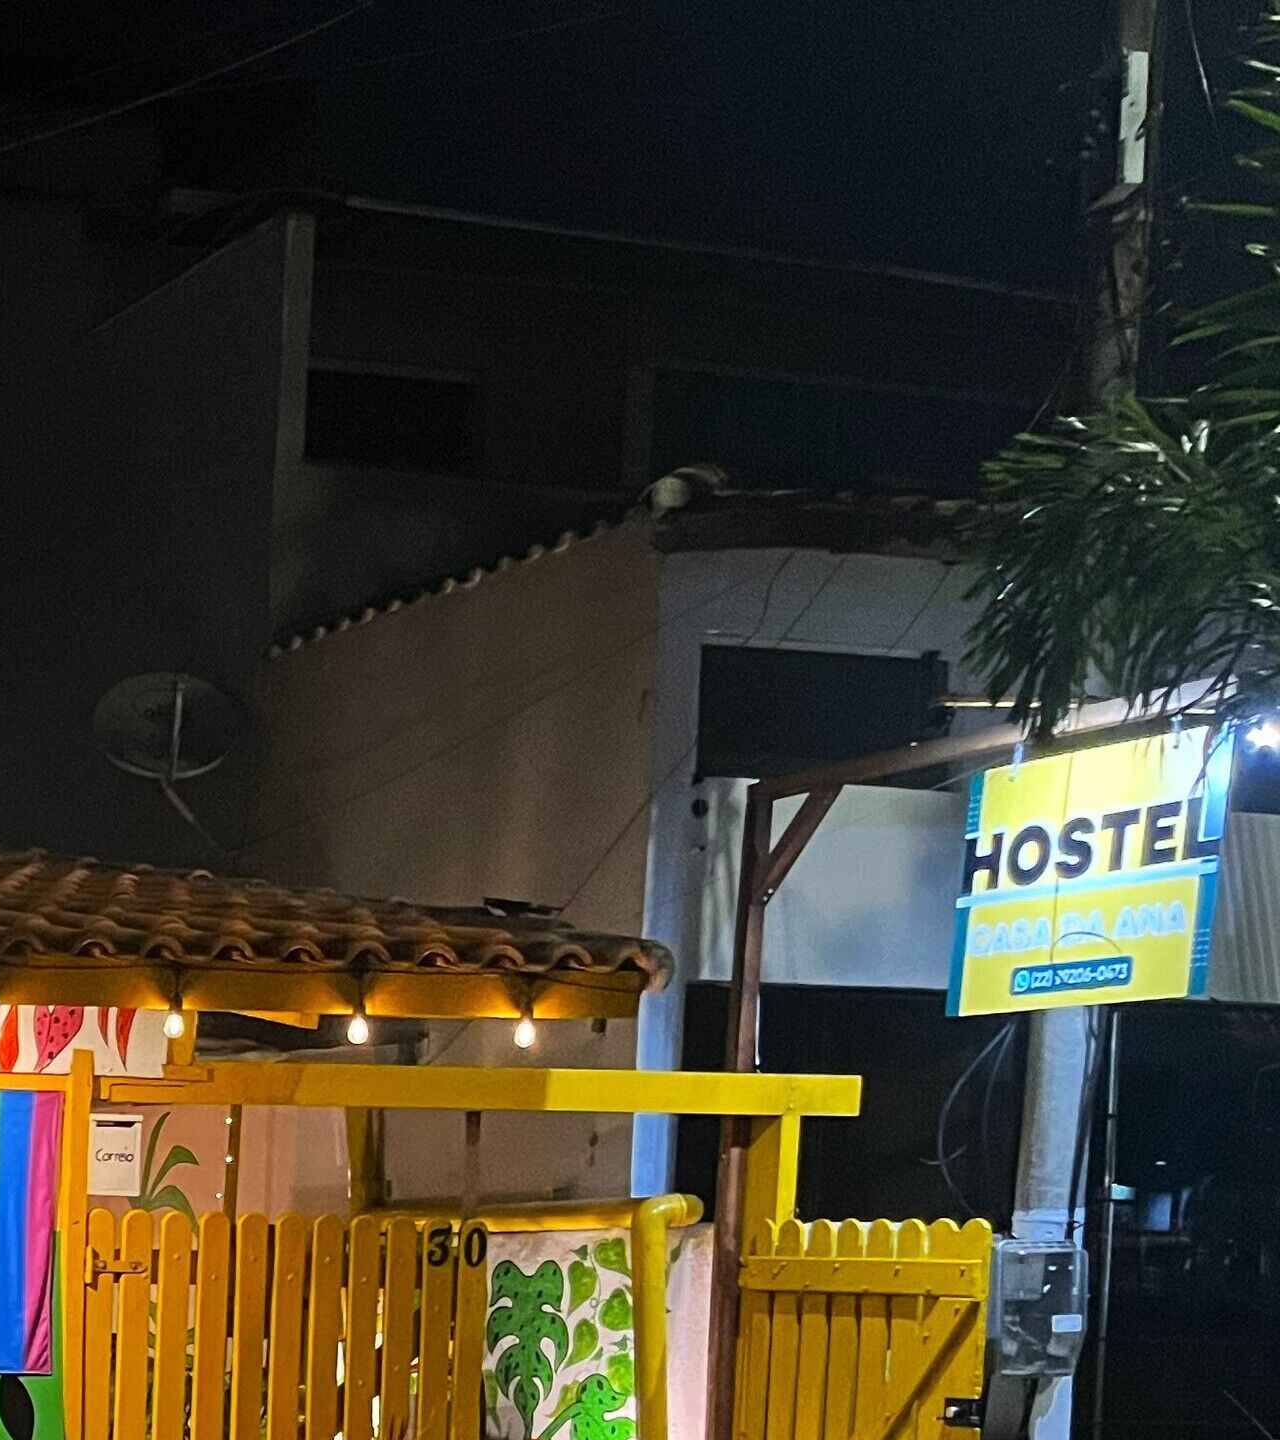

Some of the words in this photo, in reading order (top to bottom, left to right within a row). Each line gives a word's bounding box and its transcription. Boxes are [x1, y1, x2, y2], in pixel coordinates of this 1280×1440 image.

[964, 798, 1221, 894] HOSTEL
[969, 918, 1050, 956] CASA
[1114, 900, 1185, 937] ANA
[427, 1223, 488, 1268] 30
